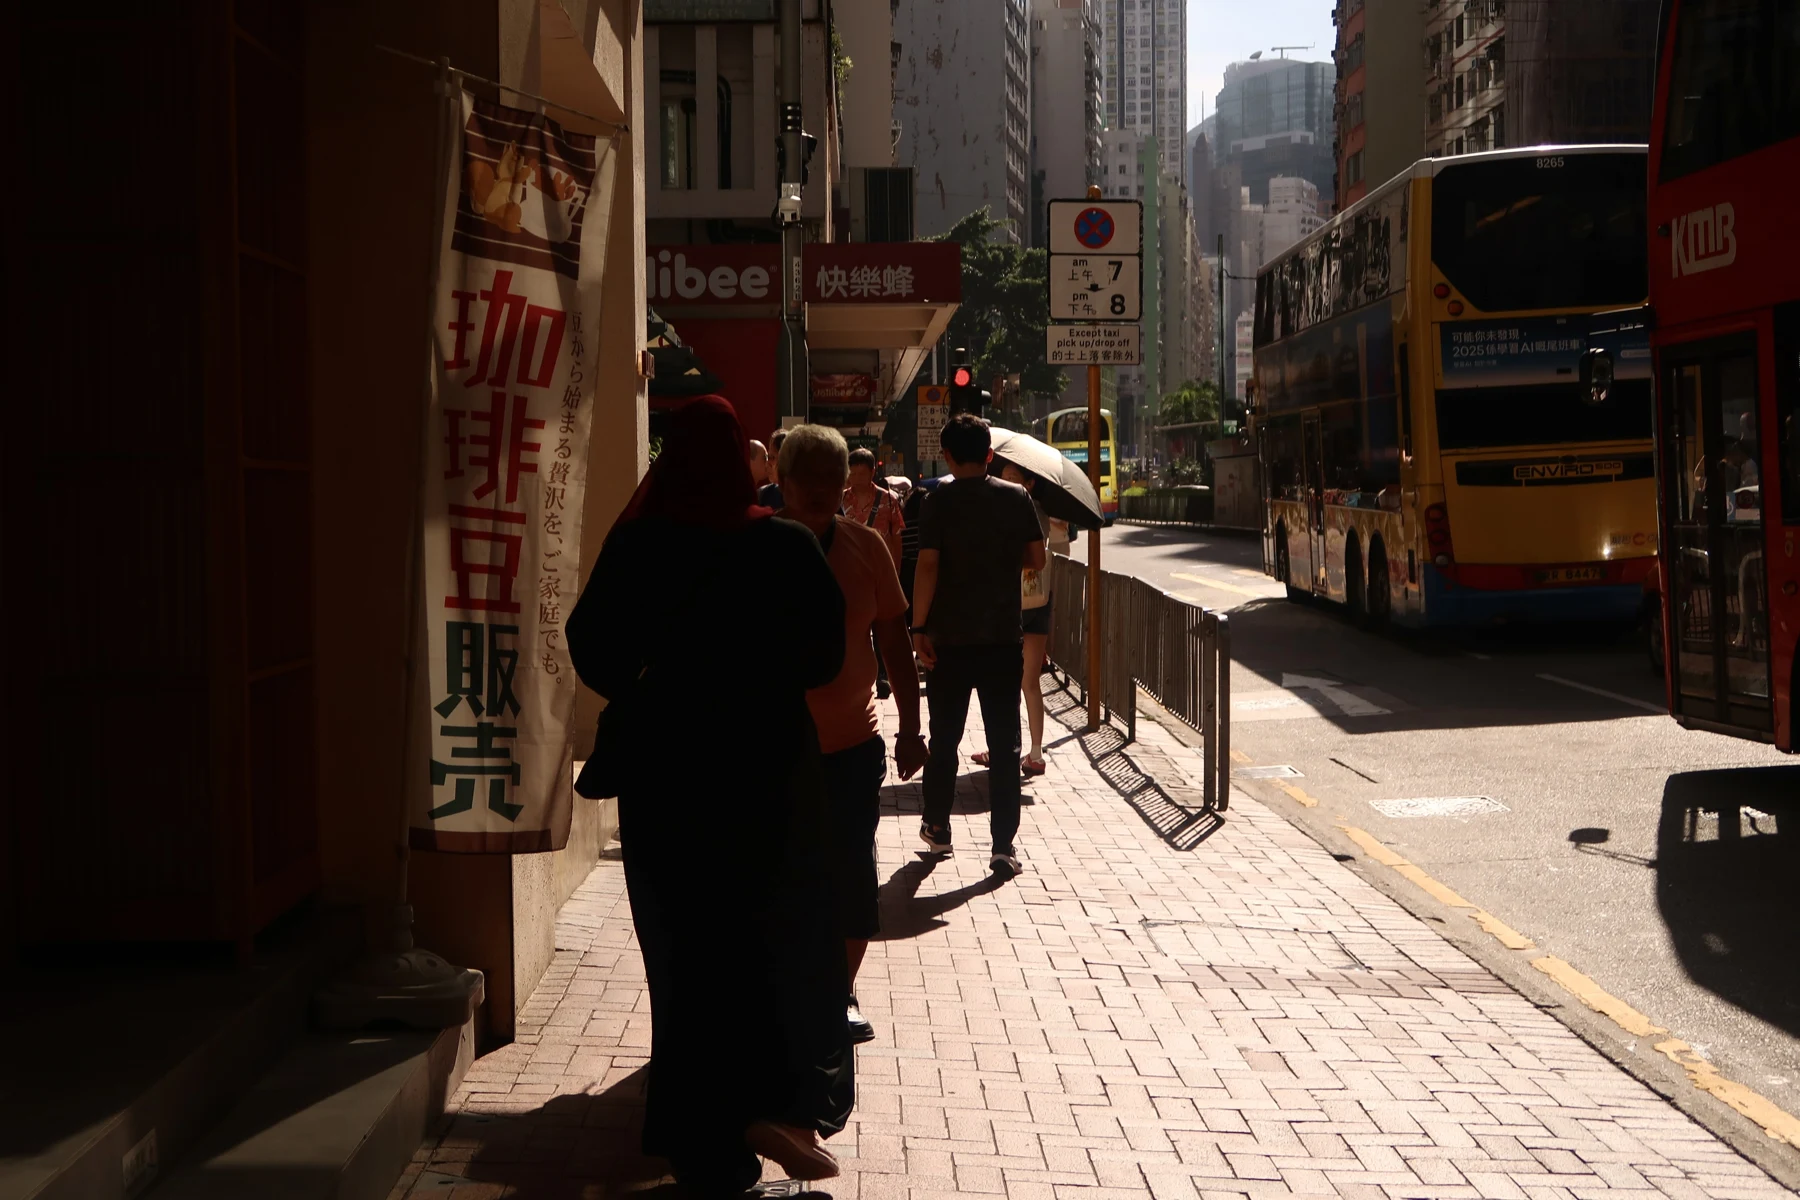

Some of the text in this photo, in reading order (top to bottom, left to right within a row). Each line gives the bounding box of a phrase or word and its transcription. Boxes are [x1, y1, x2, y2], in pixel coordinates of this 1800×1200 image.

[1536, 157, 1565, 169] 8265
[1671, 201, 1738, 279] KMB
[1068, 269, 1093, 281] 上午
[1072, 259, 1123, 281] am 7
[816, 264, 915, 298] 快樂蜂
[1068, 303, 1093, 315] 下午
[1072, 293, 1126, 315] pm 8
[1069, 328, 1120, 338] Except taxi
[1057, 338, 1130, 348] pick up/drop off
[1052, 350, 1134, 362] 的士上落客除外
[427, 269, 567, 822] 珈琲豆販売
